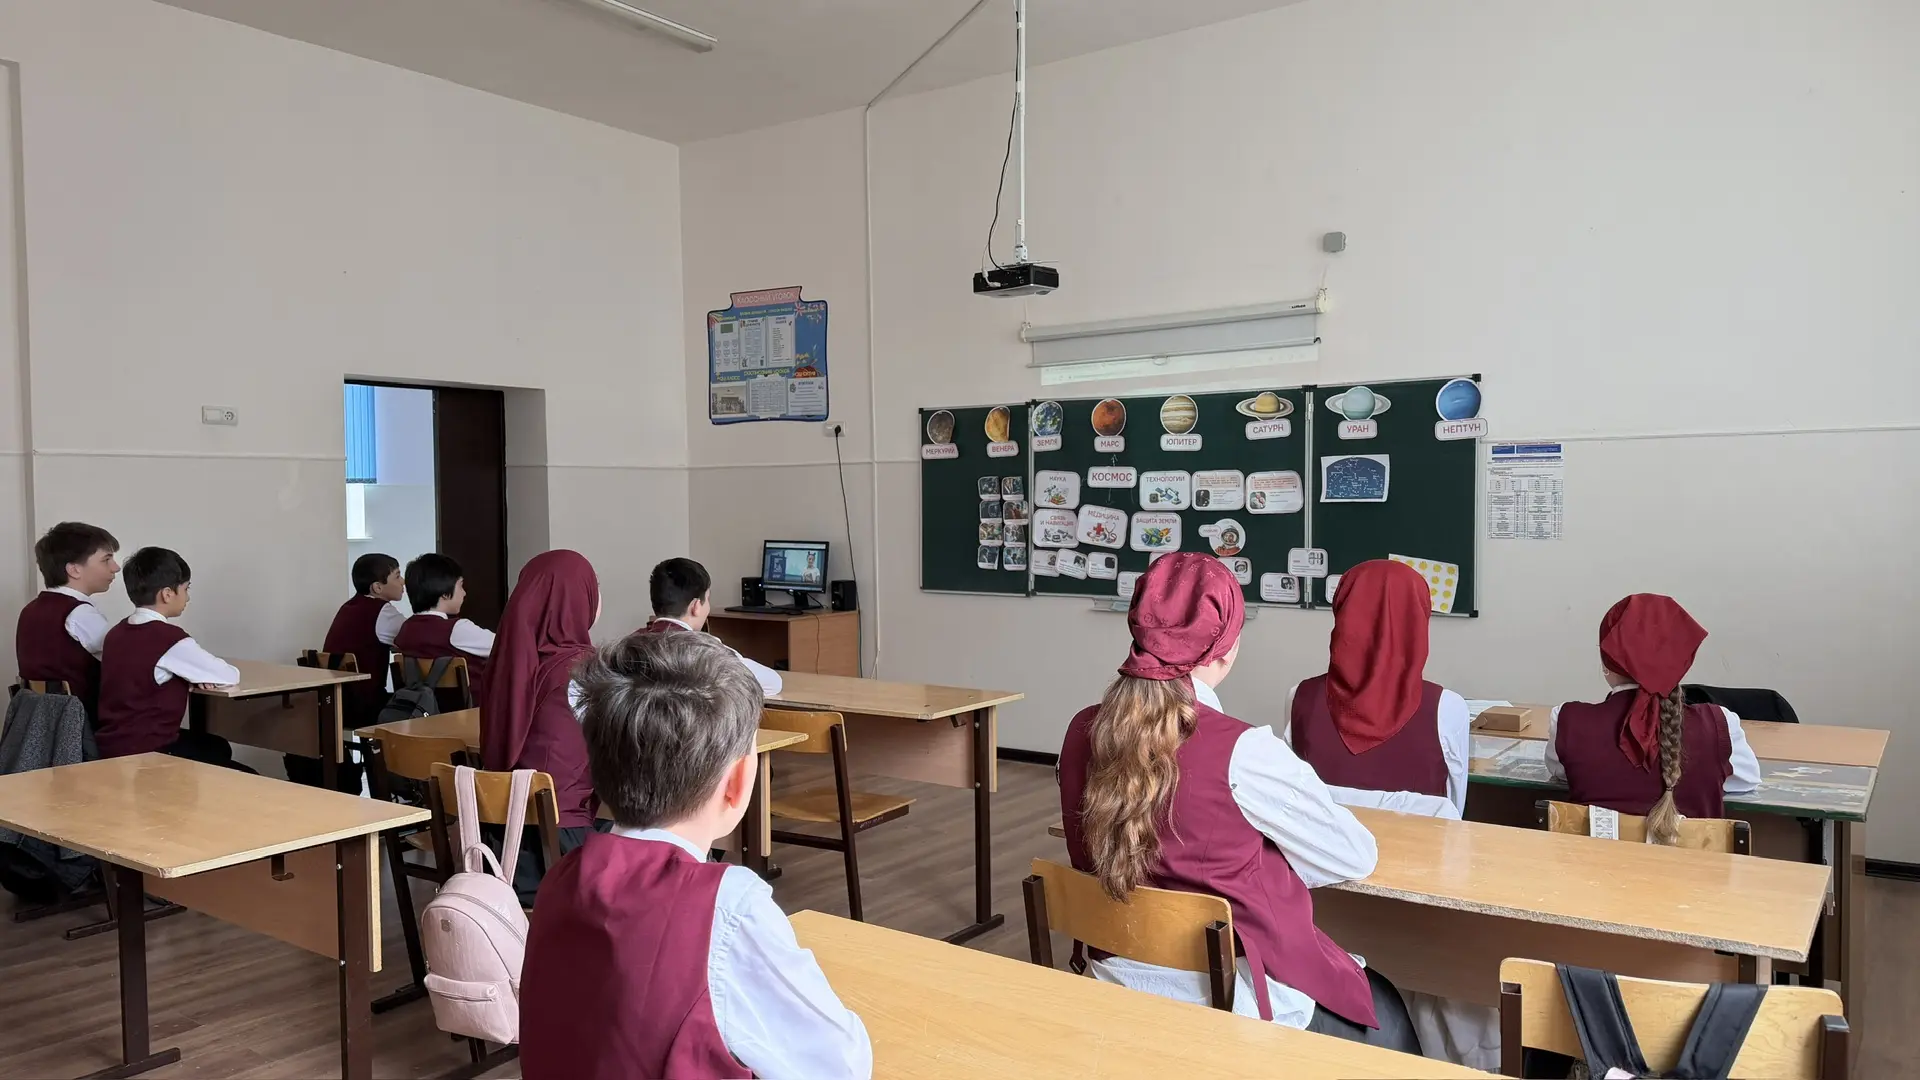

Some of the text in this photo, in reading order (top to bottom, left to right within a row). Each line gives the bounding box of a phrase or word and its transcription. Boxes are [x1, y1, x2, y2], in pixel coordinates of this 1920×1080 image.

[1252, 424, 1284, 434] САТУРН
[1346, 424, 1369, 433] УРАН
[1443, 423, 1481, 434] НЕПТУН
[1036, 439, 1058, 447] ЗЕМЛЯ
[1100, 440, 1120, 448] МАРС
[1166, 438, 1198, 446] ЮПИТЕР
[925, 446, 956, 455] МЕРКУРИЙ
[1092, 472, 1133, 482] КОСМОС
[1088, 510, 1120, 521] МЕДИЦИНА
